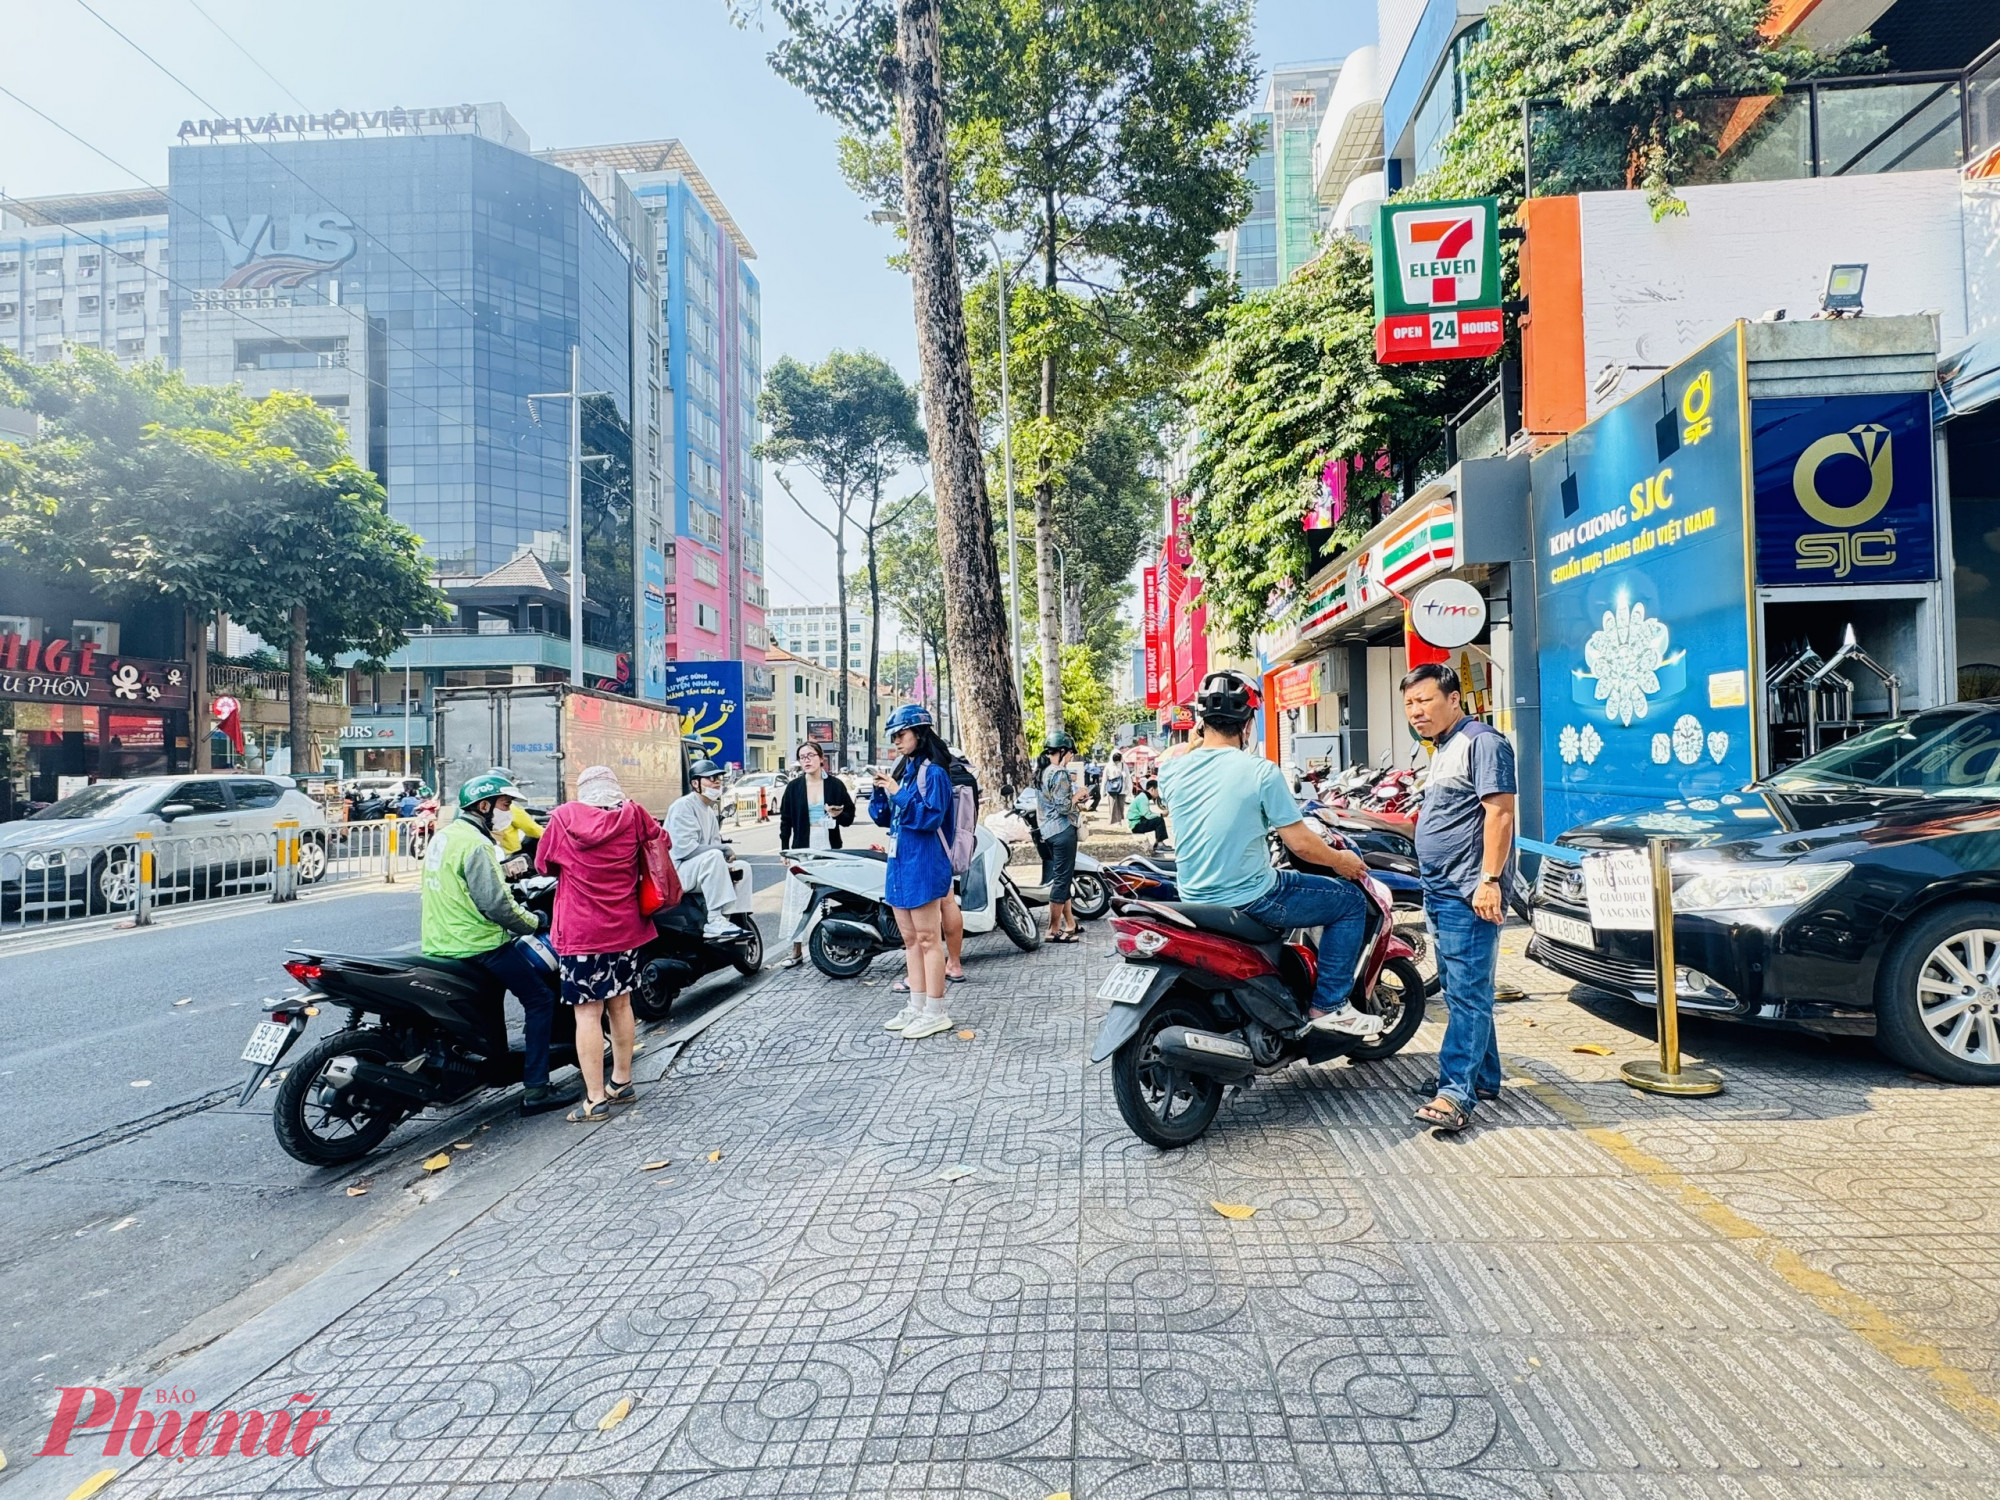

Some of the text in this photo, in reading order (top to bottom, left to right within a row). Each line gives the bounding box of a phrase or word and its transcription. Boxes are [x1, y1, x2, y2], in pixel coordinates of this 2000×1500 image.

[177, 118, 241, 138] ANH
[245, 112, 305, 134] VĂN
[210, 212, 357, 269] VUS
[1393, 320, 1499, 340] OPEN 24 HOURS
[1550, 468, 1673, 556] KIM CƯƠNG SJC
[1604, 540, 1631, 565] HÀNG
[1657, 519, 1681, 547] VIỆT
[1685, 506, 1716, 535] NAM
[1796, 530, 1896, 578] SJC
[1422, 598, 1480, 618] timo
[1147, 647, 1157, 671] MART
[1148, 671, 1158, 694] BIBO
[470, 783, 494, 796] Grab
